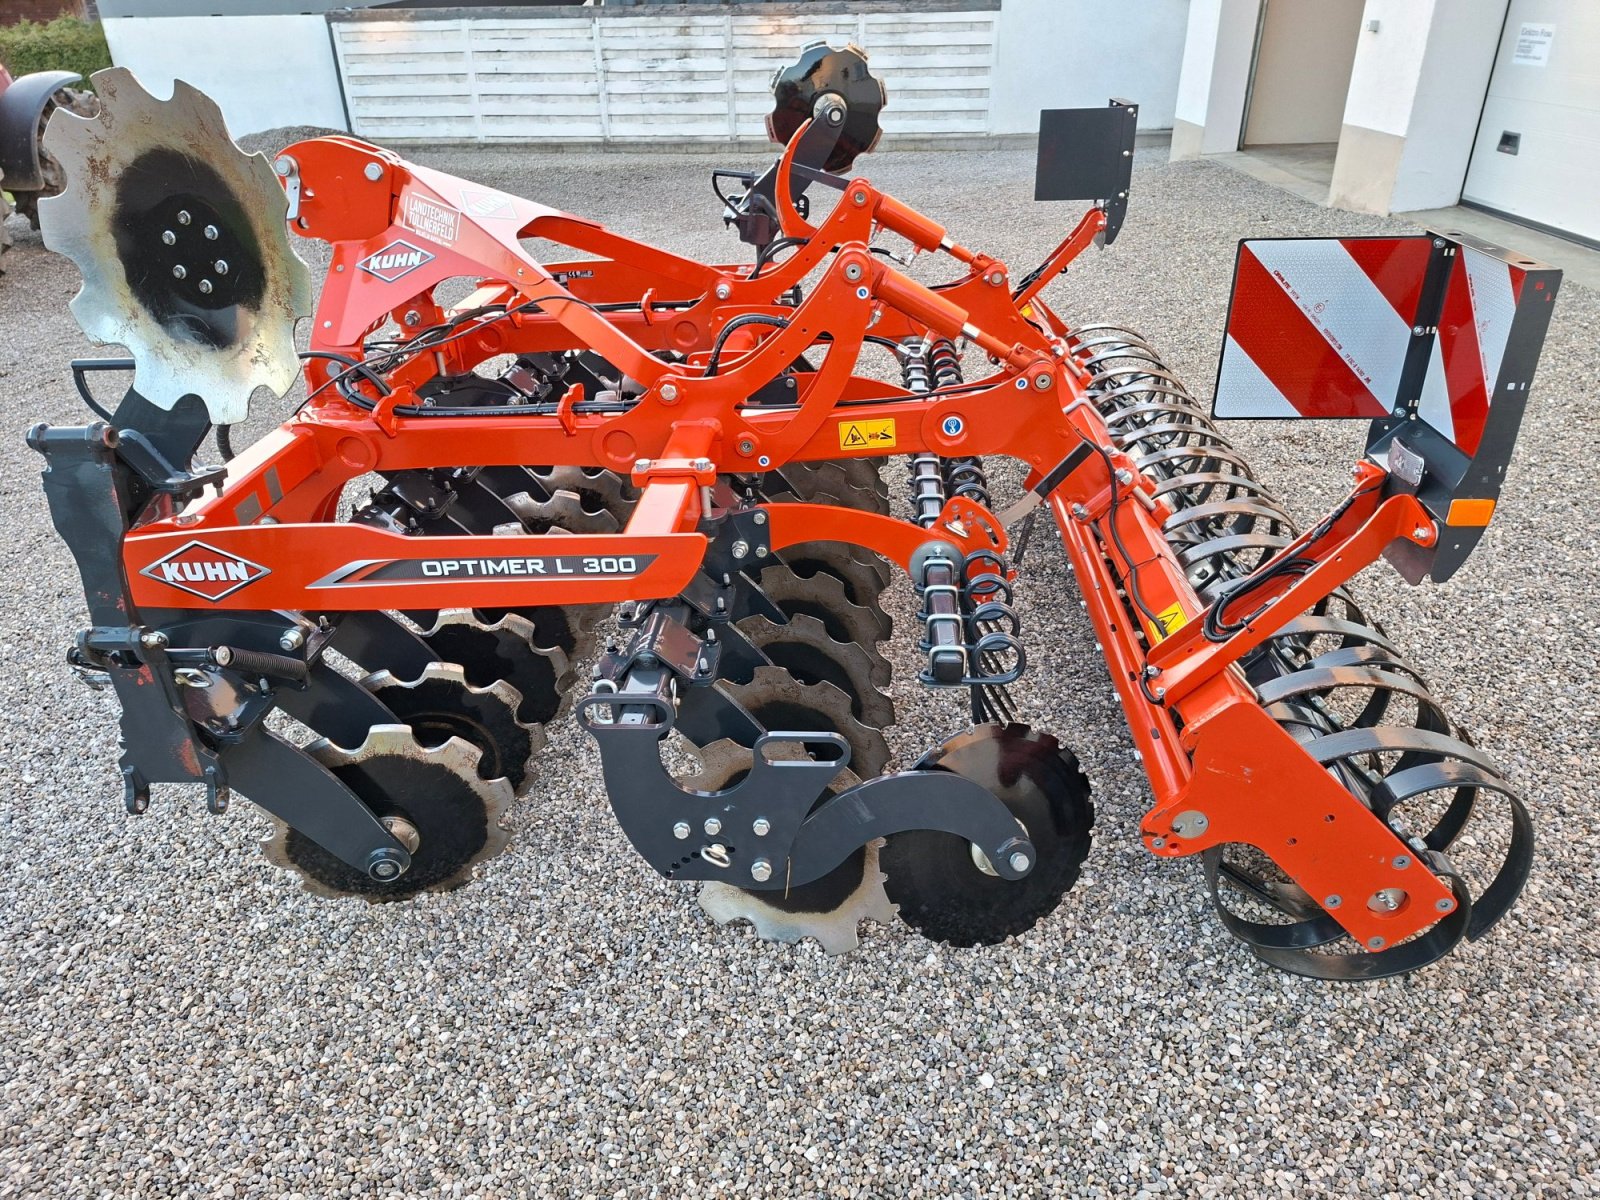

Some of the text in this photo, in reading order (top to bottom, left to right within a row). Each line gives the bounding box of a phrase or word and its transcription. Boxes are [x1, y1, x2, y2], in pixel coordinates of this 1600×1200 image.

[409, 199, 455, 228] LANDTECHNIK
[409, 211, 453, 241] TULLNERFELD
[368, 251, 422, 270] KUHN
[161, 561, 249, 582] KUHN
[421, 557, 637, 576] OPTIMER L 300
